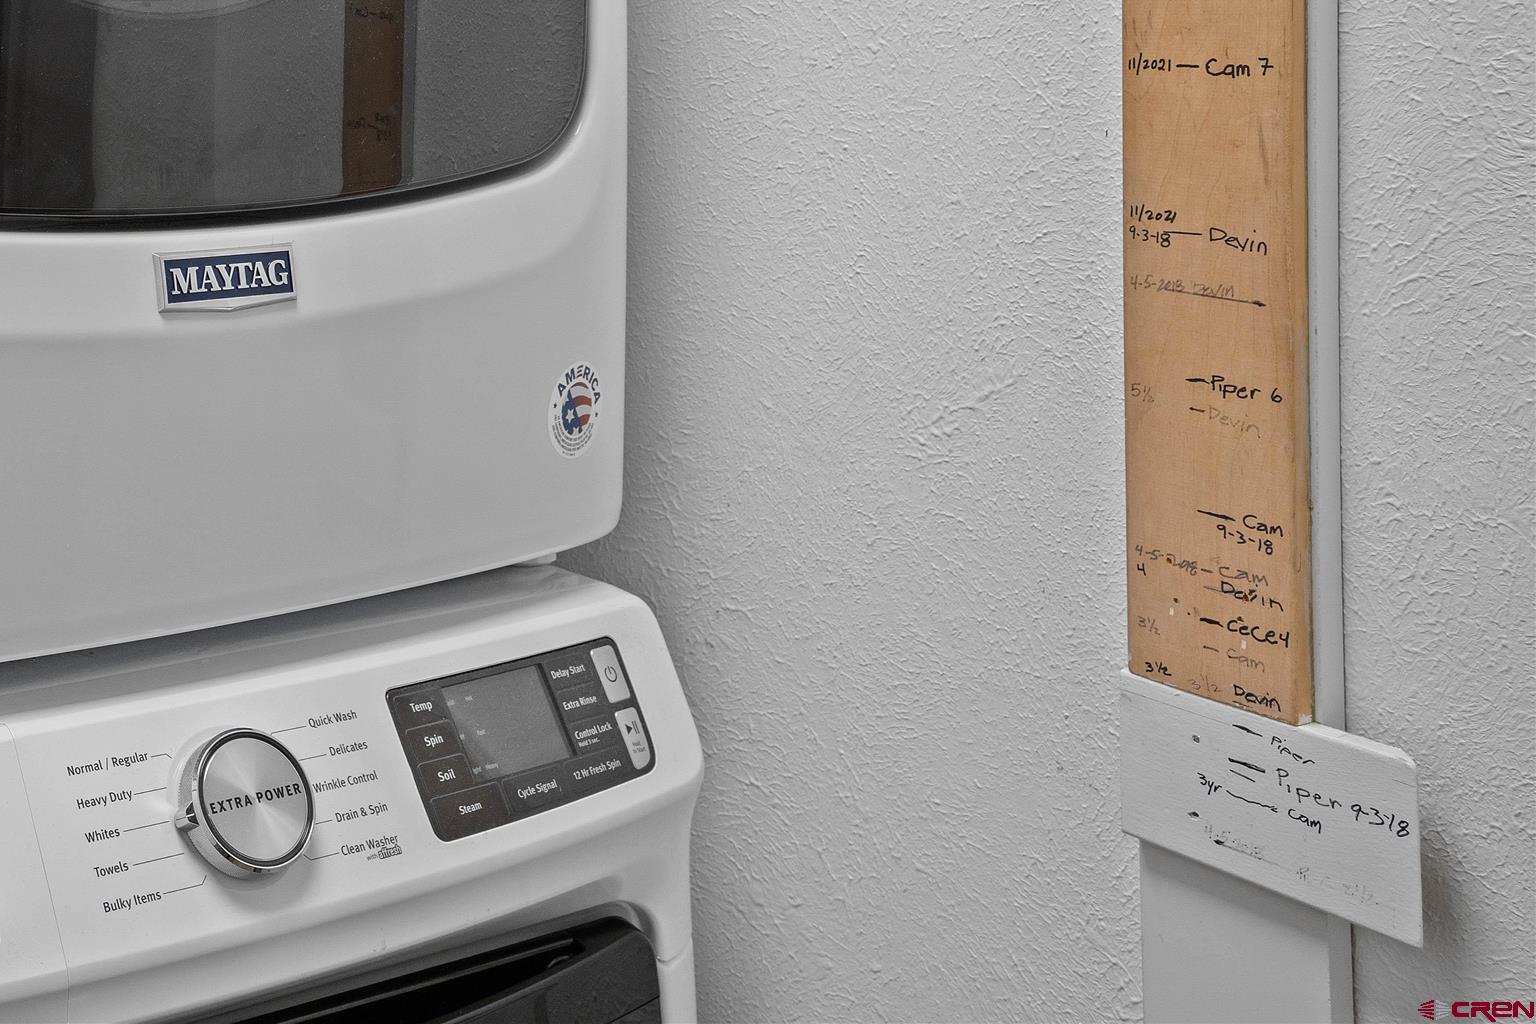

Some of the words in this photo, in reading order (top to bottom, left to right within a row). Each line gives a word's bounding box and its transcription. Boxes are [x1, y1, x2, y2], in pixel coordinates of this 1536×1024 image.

[1127, 53, 1172, 75] 11/2021
[1205, 58, 1251, 79] Cam
[1258, 57, 1274, 76] 7
[1129, 204, 1177, 223] 11/2021
[1209, 227, 1268, 256] Devin
[168, 258, 289, 296] MAYTAG
[557, 364, 601, 405] AMERICA
[1210, 375, 1261, 400] Piper
[1270, 387, 1283, 403] 6
[1242, 514, 1284, 538] Cam
[1216, 524, 1274, 556] 9-3-18
[1136, 563, 1147, 576] 4
[1218, 565, 1268, 587] Cam
[550, 668, 570, 680] Delay
[569, 663, 586, 675] Start
[1227, 648, 1265, 673] Cam
[409, 700, 433, 714] Temp
[562, 699, 580, 711] Extra
[579, 695, 598, 707] Rinse
[1233, 684, 1282, 712] Devin
[308, 715, 332, 729] Quick
[333, 709, 358, 724] Wash
[424, 734, 444, 748] Spin
[574, 726, 598, 740] Control
[597, 721, 614, 734] Lock
[328, 740, 368, 757] Delicates
[1270, 734, 1315, 766] Piper
[67, 759, 104, 777] Normal
[111, 751, 149, 768] Regular
[437, 768, 456, 782] Soil
[573, 771, 582, 781] 12
[581, 768, 590, 778] Hr
[589, 762, 606, 776] Fresh
[606, 758, 622, 770] Spin
[312, 777, 346, 793] Wrinkle
[347, 770, 379, 786] Control
[517, 785, 536, 800] Cycle
[536, 779, 558, 795] Signal
[1275, 767, 1342, 810] Piper
[76, 793, 107, 810] Heavy
[109, 789, 133, 804] Duty
[209, 794, 253, 815] EXTRA
[256, 783, 303, 803] POWER
[458, 801, 483, 815] Steam
[1197, 771, 1223, 795] 3yr
[1287, 808, 1322, 834] Cam
[335, 808, 360, 823] Drain
[360, 807, 368, 817] &
[368, 802, 389, 817] Spin
[84, 827, 121, 844] Whites
[341, 841, 365, 857] Clean
[366, 834, 399, 851] Washer
[378, 845, 403, 860] affresh
[93, 861, 129, 878] Towels
[103, 896, 132, 914] Bulky
[133, 890, 162, 905] Items
